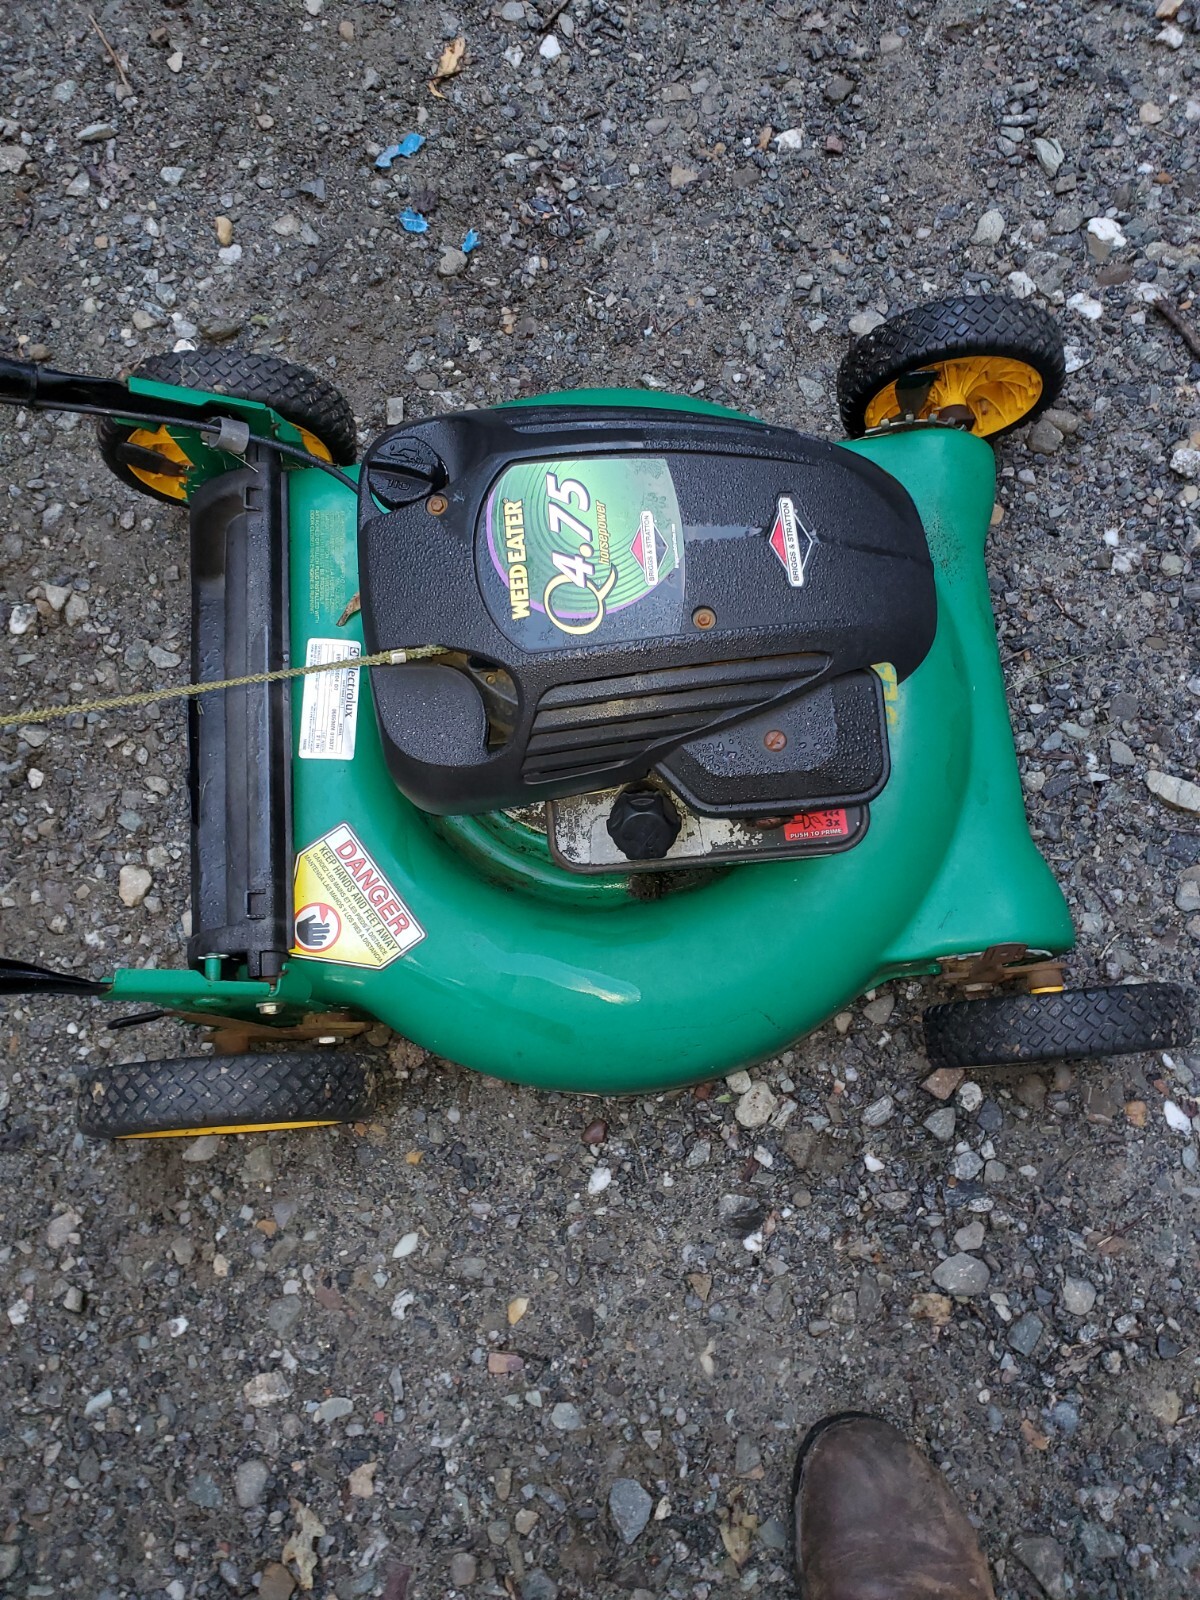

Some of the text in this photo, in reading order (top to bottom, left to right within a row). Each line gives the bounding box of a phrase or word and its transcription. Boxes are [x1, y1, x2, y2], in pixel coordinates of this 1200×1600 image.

[386, 479, 411, 490] OIL
[595, 501, 610, 566] horsepower
[643, 515, 652, 548] STRATTON
[782, 502, 794, 542] STRATTON
[645, 556, 655, 581] BRIGGS
[789, 552, 800, 581] BRIGGS
[508, 565, 531, 620] WEED
[345, 662, 359, 718] lectrolux
[826, 818, 840, 827] 3x
[304, 855, 325, 881] MANTENGA
[322, 881, 332, 891] LAS
[329, 891, 344, 909] MANOS
[345, 912, 354, 923] LOS
[352, 922, 362, 934] PIES
[363, 938, 383, 963] DISTANCIA
[319, 846, 395, 951] KEEP HANDS AND FEET AWAY
[335, 840, 410, 936] DANGER
[356, 913, 368, 928] PIEDS
[369, 931, 388, 955] DISTANCE
